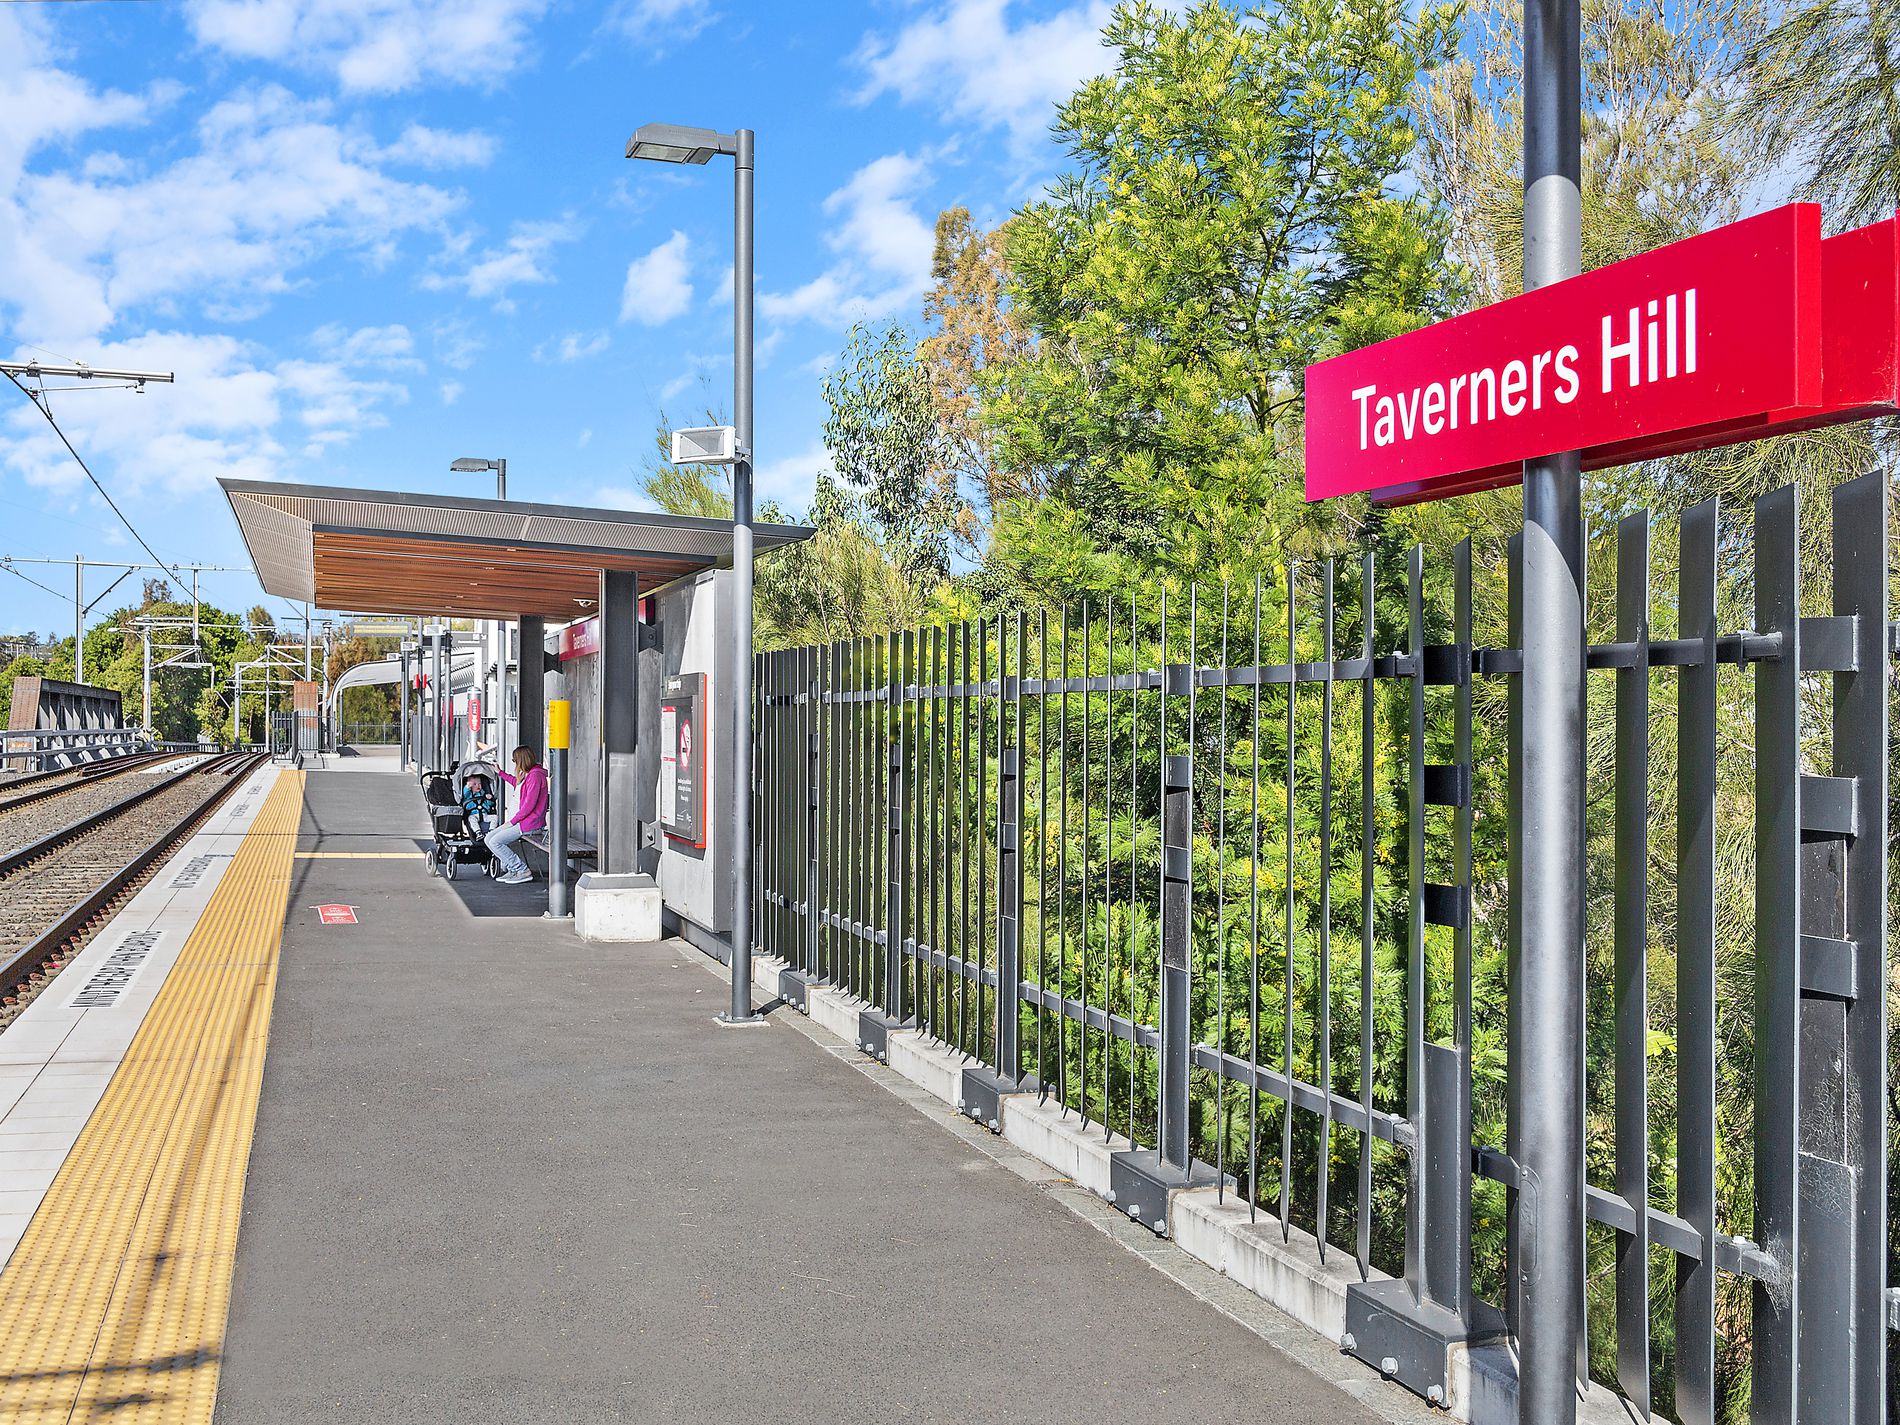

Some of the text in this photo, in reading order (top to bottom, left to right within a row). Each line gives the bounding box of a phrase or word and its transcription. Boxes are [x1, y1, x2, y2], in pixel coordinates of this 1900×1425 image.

[1351, 289, 1697, 450] Taverners Hill
[69, 990, 121, 1008] MIND
